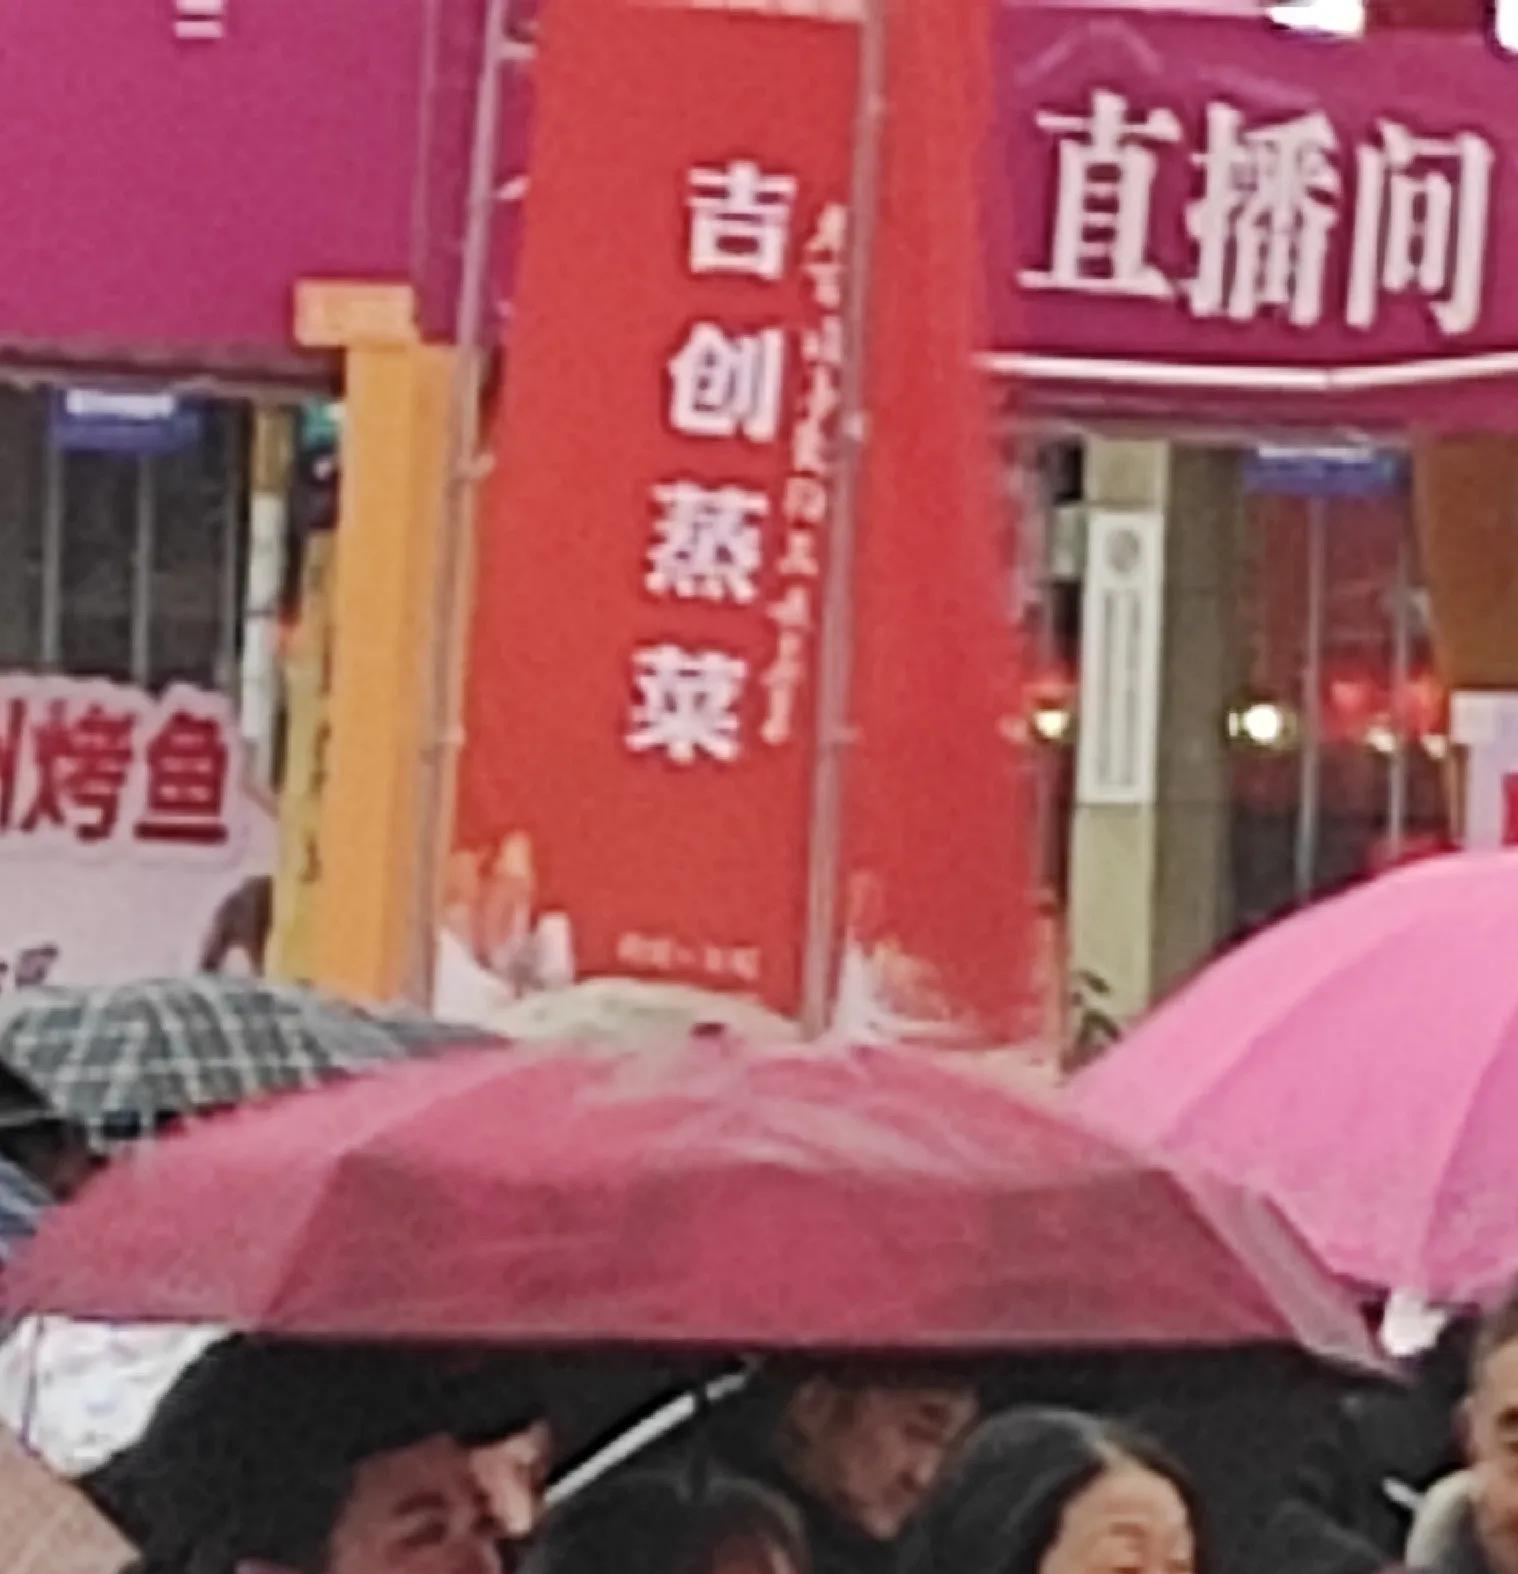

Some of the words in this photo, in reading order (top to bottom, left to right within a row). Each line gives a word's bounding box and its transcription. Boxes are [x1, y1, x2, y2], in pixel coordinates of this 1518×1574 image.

[1016, 89, 1494, 335] 直播间
[624, 160, 798, 764] 吉创蒸菜
